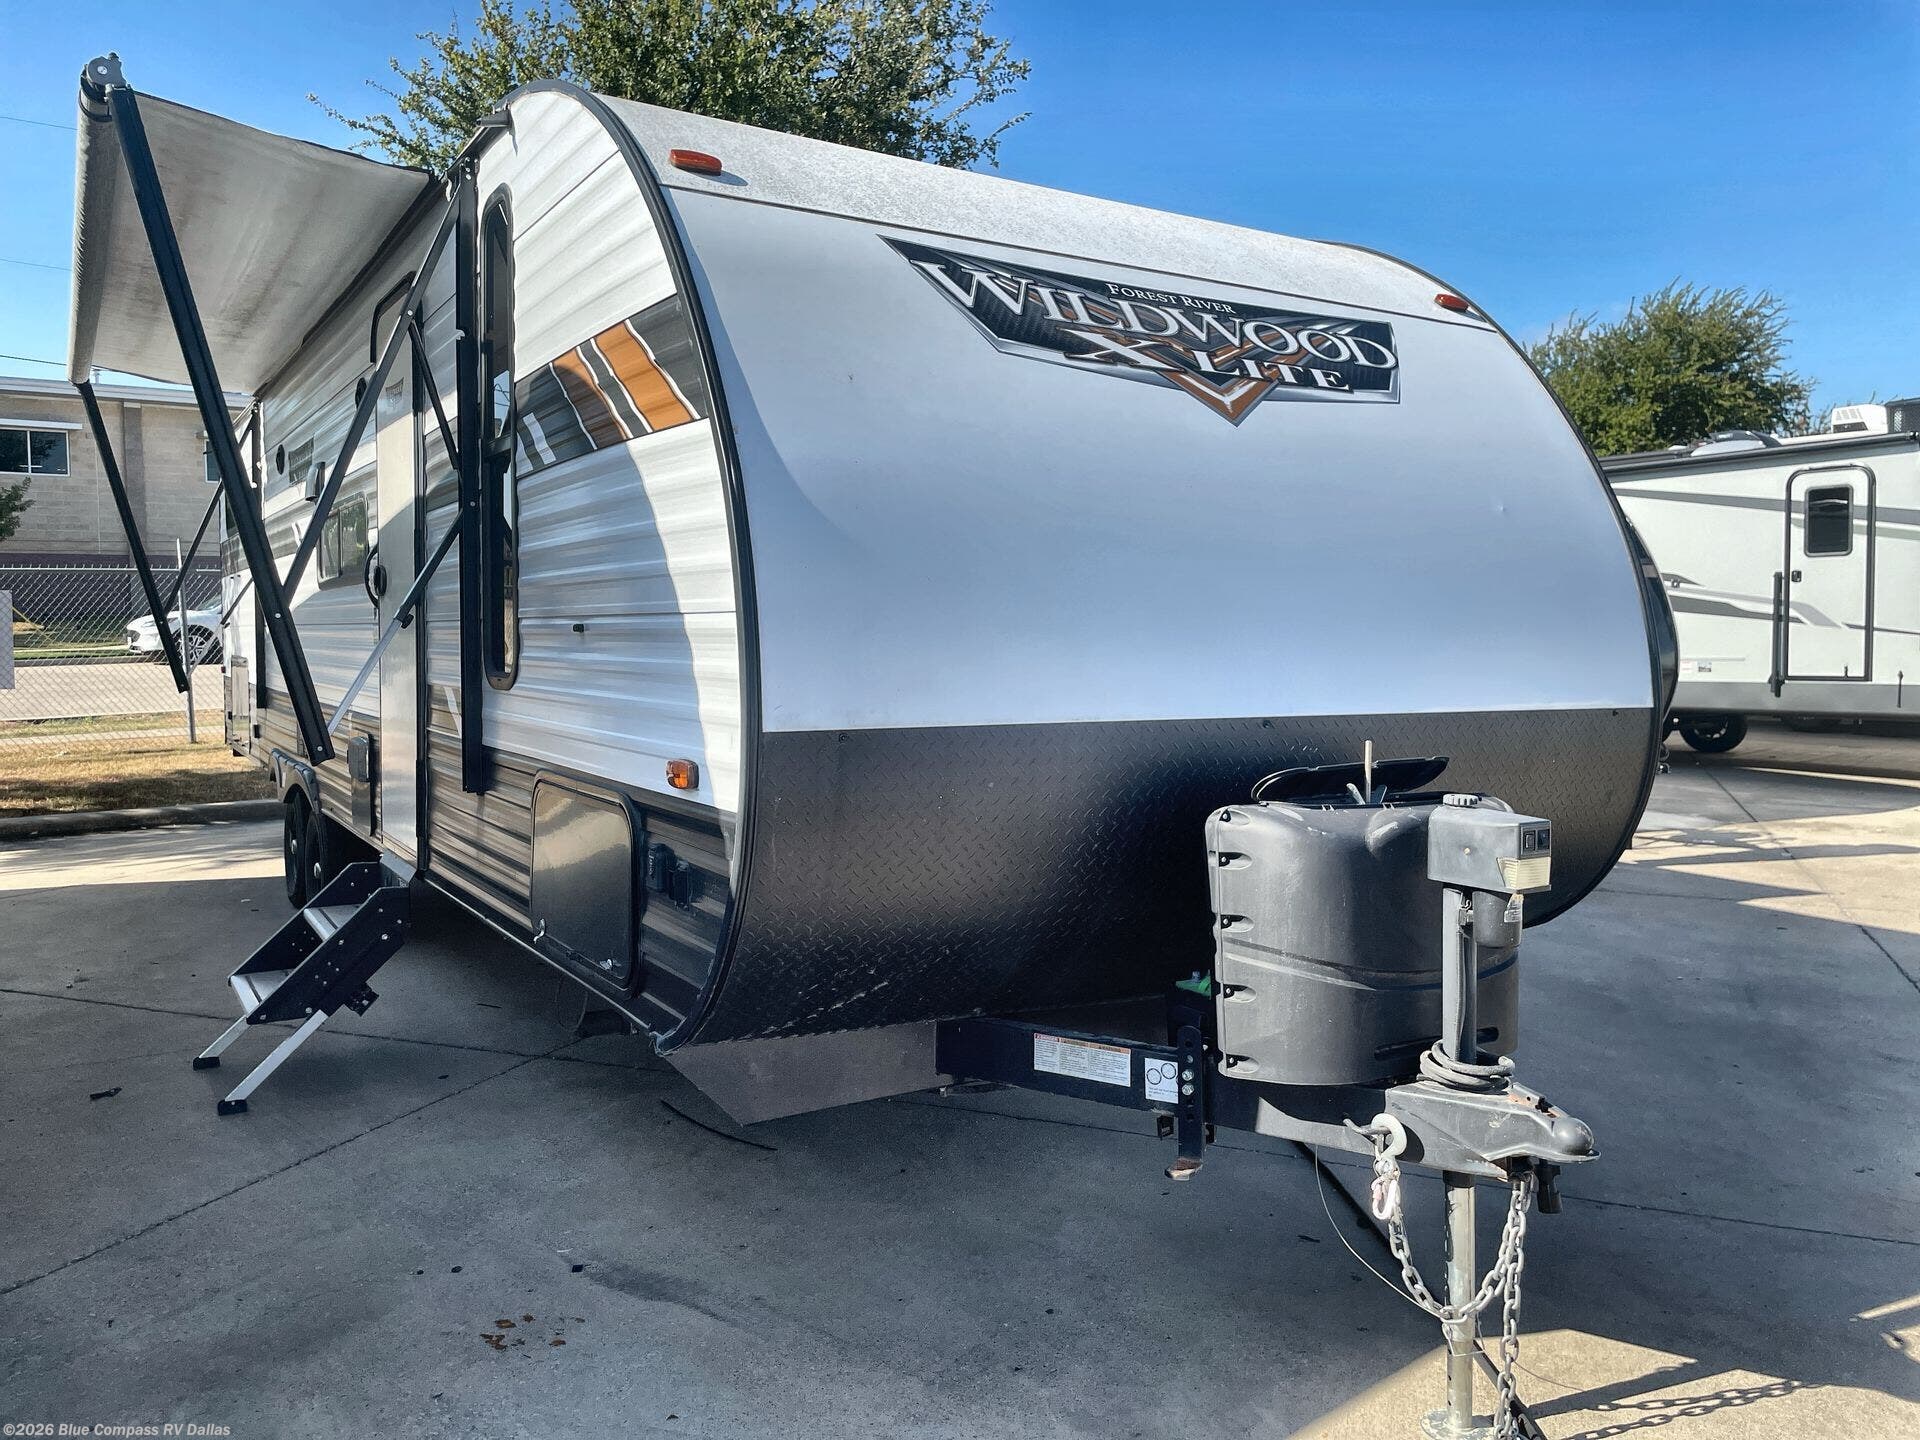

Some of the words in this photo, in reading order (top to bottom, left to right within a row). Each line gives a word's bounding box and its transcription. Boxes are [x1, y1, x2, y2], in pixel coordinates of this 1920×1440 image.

[908, 259, 1398, 369] WILDWOOD
[1104, 283, 1178, 305] FOREST
[1179, 295, 1237, 314] RIVER
[1192, 350, 1351, 391] LITE
